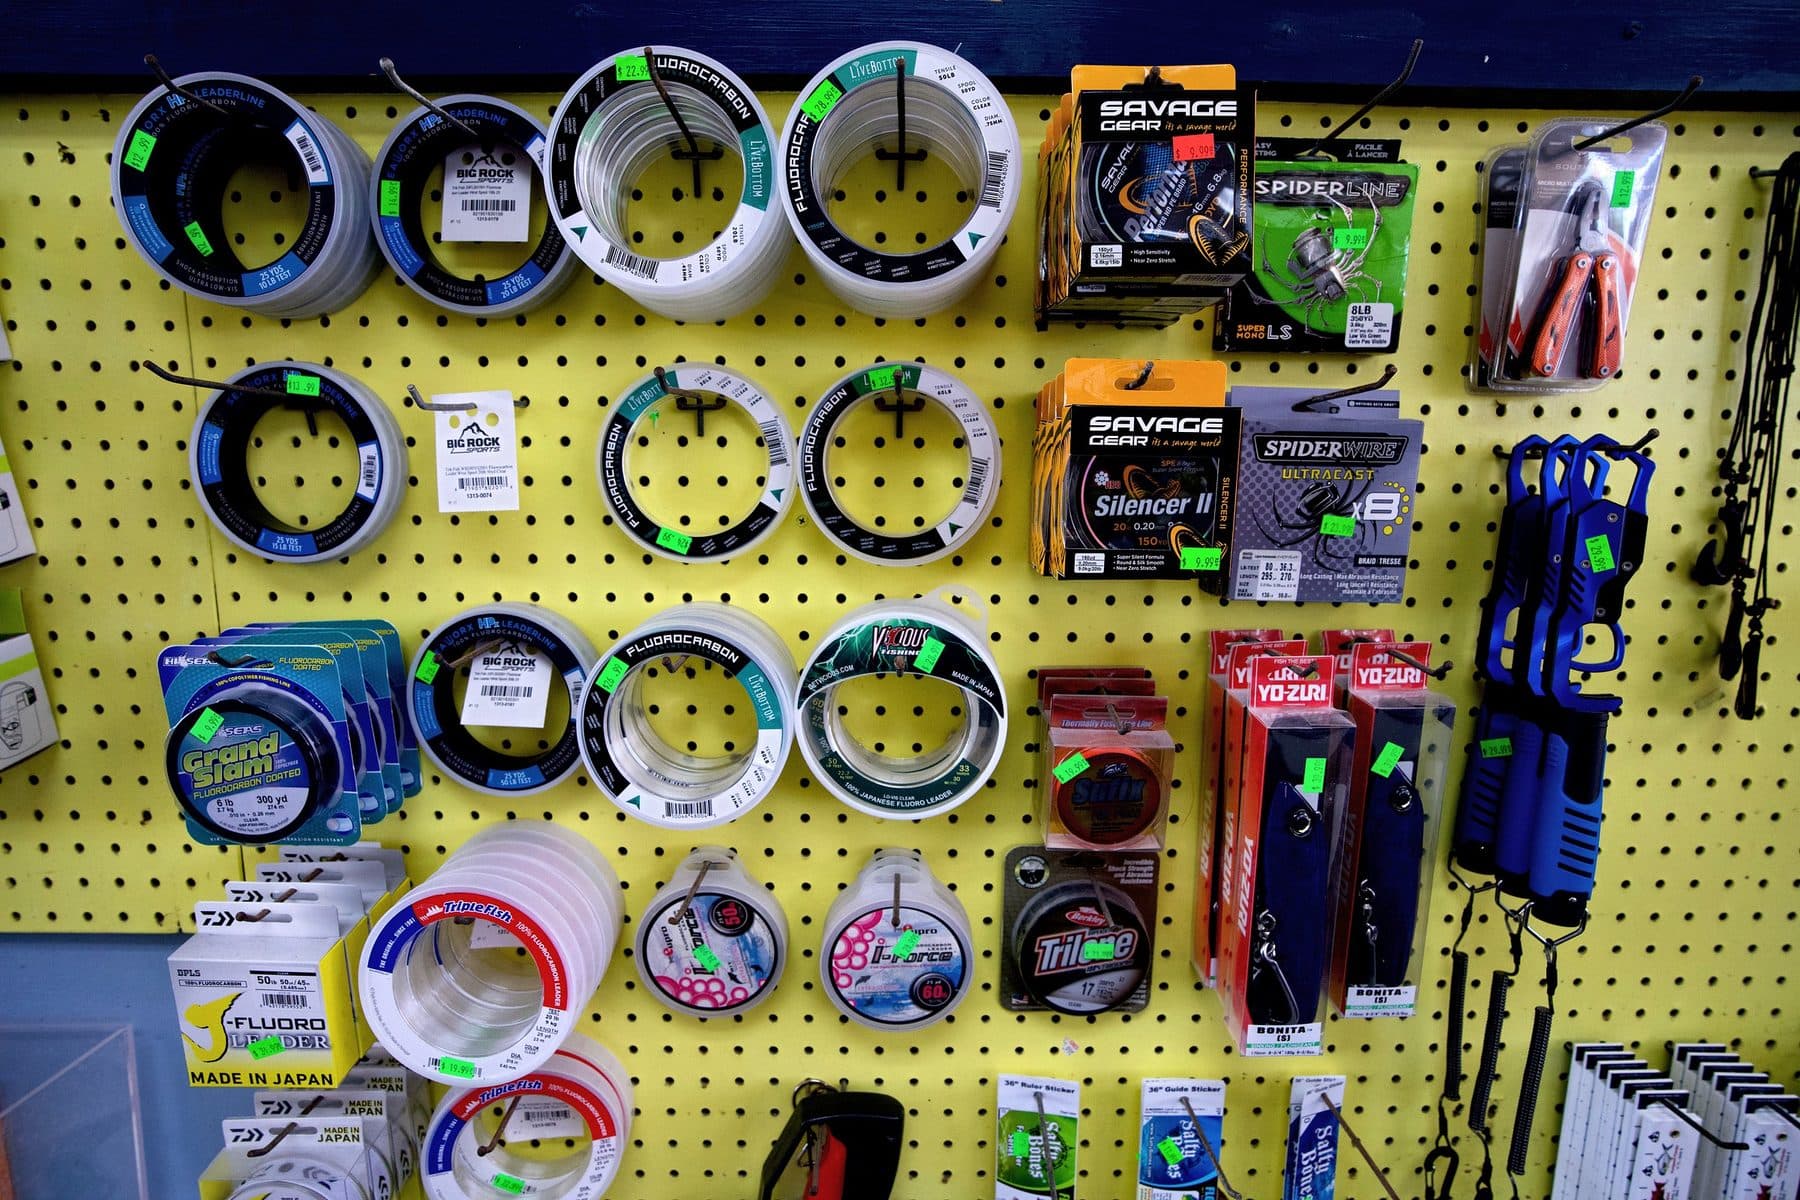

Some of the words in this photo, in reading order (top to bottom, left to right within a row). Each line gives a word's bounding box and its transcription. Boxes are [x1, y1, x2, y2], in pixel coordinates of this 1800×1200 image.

[934, 65, 957, 75] TENSILE
[957, 80, 976, 89] SPOOL
[971, 96, 991, 105] COLOR
[973, 102, 991, 110] CLEAR
[1100, 100, 1238, 117] SAVAGE
[1100, 120, 1162, 131] GEAR
[1185, 122, 1214, 135] savage
[1215, 120, 1237, 131] world
[457, 169, 477, 179] BIG
[479, 169, 514, 178] ROCK
[1238, 148, 1249, 225] PERFORMANCE
[258, 281, 267, 290] 10
[266, 276, 276, 287] LB
[275, 269, 292, 284] TEST
[259, 271, 270, 281] 25
[269, 264, 284, 278] YDS
[501, 289, 510, 299] 20
[508, 285, 517, 296] LB
[516, 278, 533, 292] TEST
[502, 280, 512, 289] 25
[511, 273, 524, 285] YDS
[1351, 305, 1371, 315] 8LB
[1237, 324, 1265, 332] SUPER
[1267, 325, 1293, 340] LS
[1089, 416, 1223, 434] SAVAGE
[447, 439, 465, 449] BIG
[467, 437, 500, 447] ROCK
[803, 388, 848, 493] FLUOROCARBON
[1089, 436, 1148, 447] GEAR
[1172, 439, 1199, 450] savage
[1200, 436, 1222, 447] world
[1264, 441, 1397, 458] SPIDERWIRE
[605, 423, 640, 529] FLUOROCARBON
[1282, 468, 1375, 480] ULTRACAST
[1094, 495, 1192, 517] Silencer
[1196, 493, 1213, 514] II
[1220, 477, 1230, 522] SILENCER
[1134, 522, 1155, 531] 0.20
[277, 537, 285, 545] 25
[1358, 557, 1377, 565] BRAID
[1261, 572, 1273, 581] 295
[1280, 573, 1292, 581] 270
[626, 634, 739, 663] FLUOROCARBON
[279, 657, 335, 665] FLUOROCARBON
[483, 657, 501, 666] BIG
[504, 658, 536, 666] ROCK
[1358, 668, 1421, 684] YO-ZURI
[952, 670, 970, 683] MADE
[969, 679, 976, 687] IN
[975, 683, 995, 699] JAPAN
[1258, 684, 1327, 702] YO-ZURI
[183, 733, 280, 774] Grand
[192, 753, 274, 790] Slam
[194, 777, 265, 800] FLUOROCARBON
[266, 769, 301, 784] COATED
[217, 799, 223, 808] 6
[225, 798, 234, 807] lb
[257, 795, 273, 804] 300
[276, 795, 288, 804] yd
[845, 782, 860, 796] 100%
[860, 792, 896, 806] JAPANESE
[926, 790, 953, 804] LEADER
[515, 921, 532, 936] 100%
[530, 932, 560, 982] FLUOROCARBON
[553, 981, 561, 1008] LEADER
[177, 969, 201, 977] DPLS
[1082, 981, 1095, 996] 17
[1374, 996, 1388, 1004] (S)
[1257, 1026, 1306, 1034] BONITA
[1277, 1034, 1291, 1042] (S)
[191, 1072, 241, 1085] MADE
[249, 1073, 267, 1085] IN
[274, 1073, 333, 1086] JAPAN
[564, 1087, 601, 1121] FLUOROCARBON
[597, 1119, 607, 1137] LEADER
[318, 1134, 360, 1143] JAPAN
